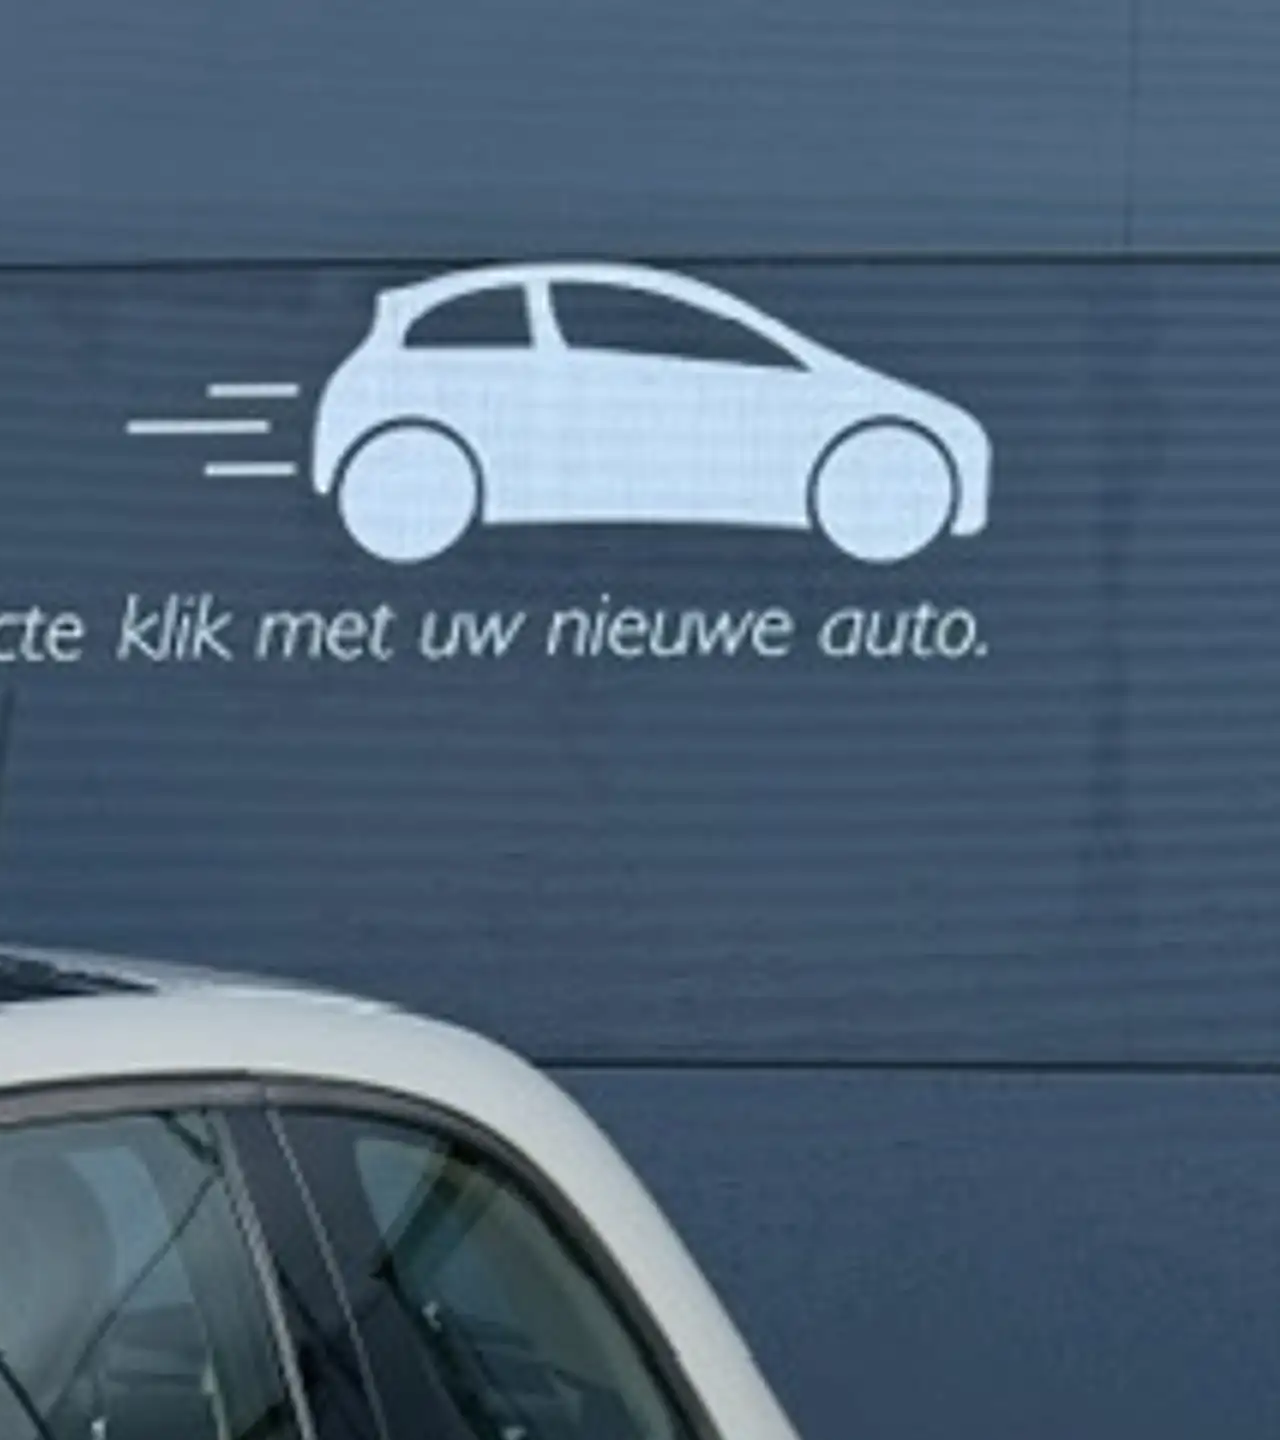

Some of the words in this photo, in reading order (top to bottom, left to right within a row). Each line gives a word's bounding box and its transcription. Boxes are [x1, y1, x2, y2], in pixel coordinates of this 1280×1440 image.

[117, 592, 233, 662] klik
[255, 603, 397, 662] met
[419, 610, 527, 661] uw
[546, 592, 794, 658] nieuwe
[818, 602, 988, 660] auto.
